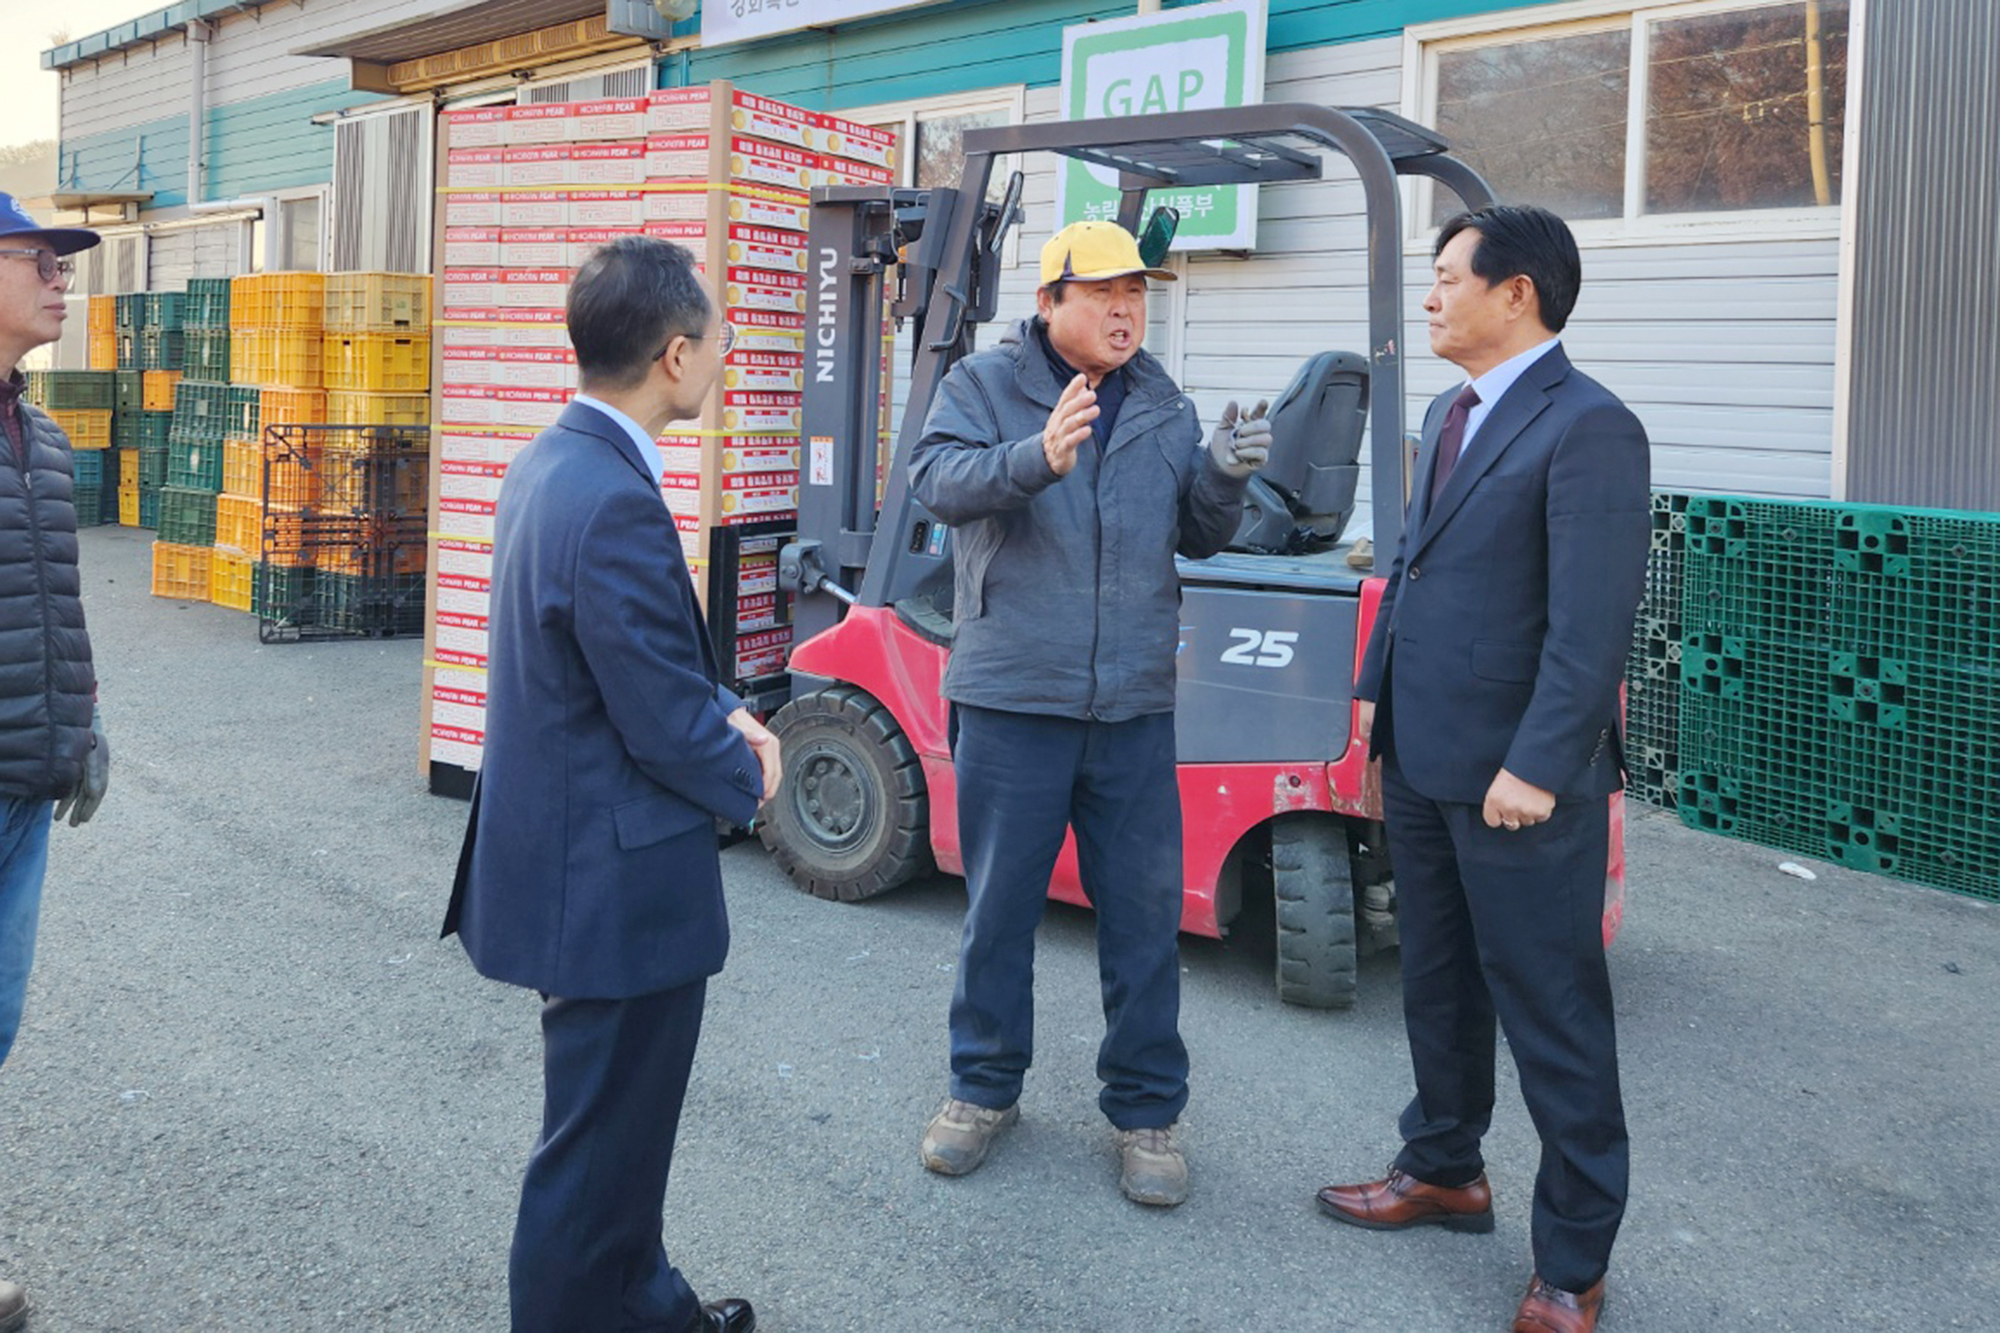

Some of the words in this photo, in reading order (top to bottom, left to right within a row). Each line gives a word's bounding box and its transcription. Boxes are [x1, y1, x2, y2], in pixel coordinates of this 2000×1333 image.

[1103, 69, 1204, 118] GAP
[1083, 193, 1214, 222] 농림산식품부
[816, 247, 838, 383] NICHIYU
[1220, 628, 1299, 667] 25
